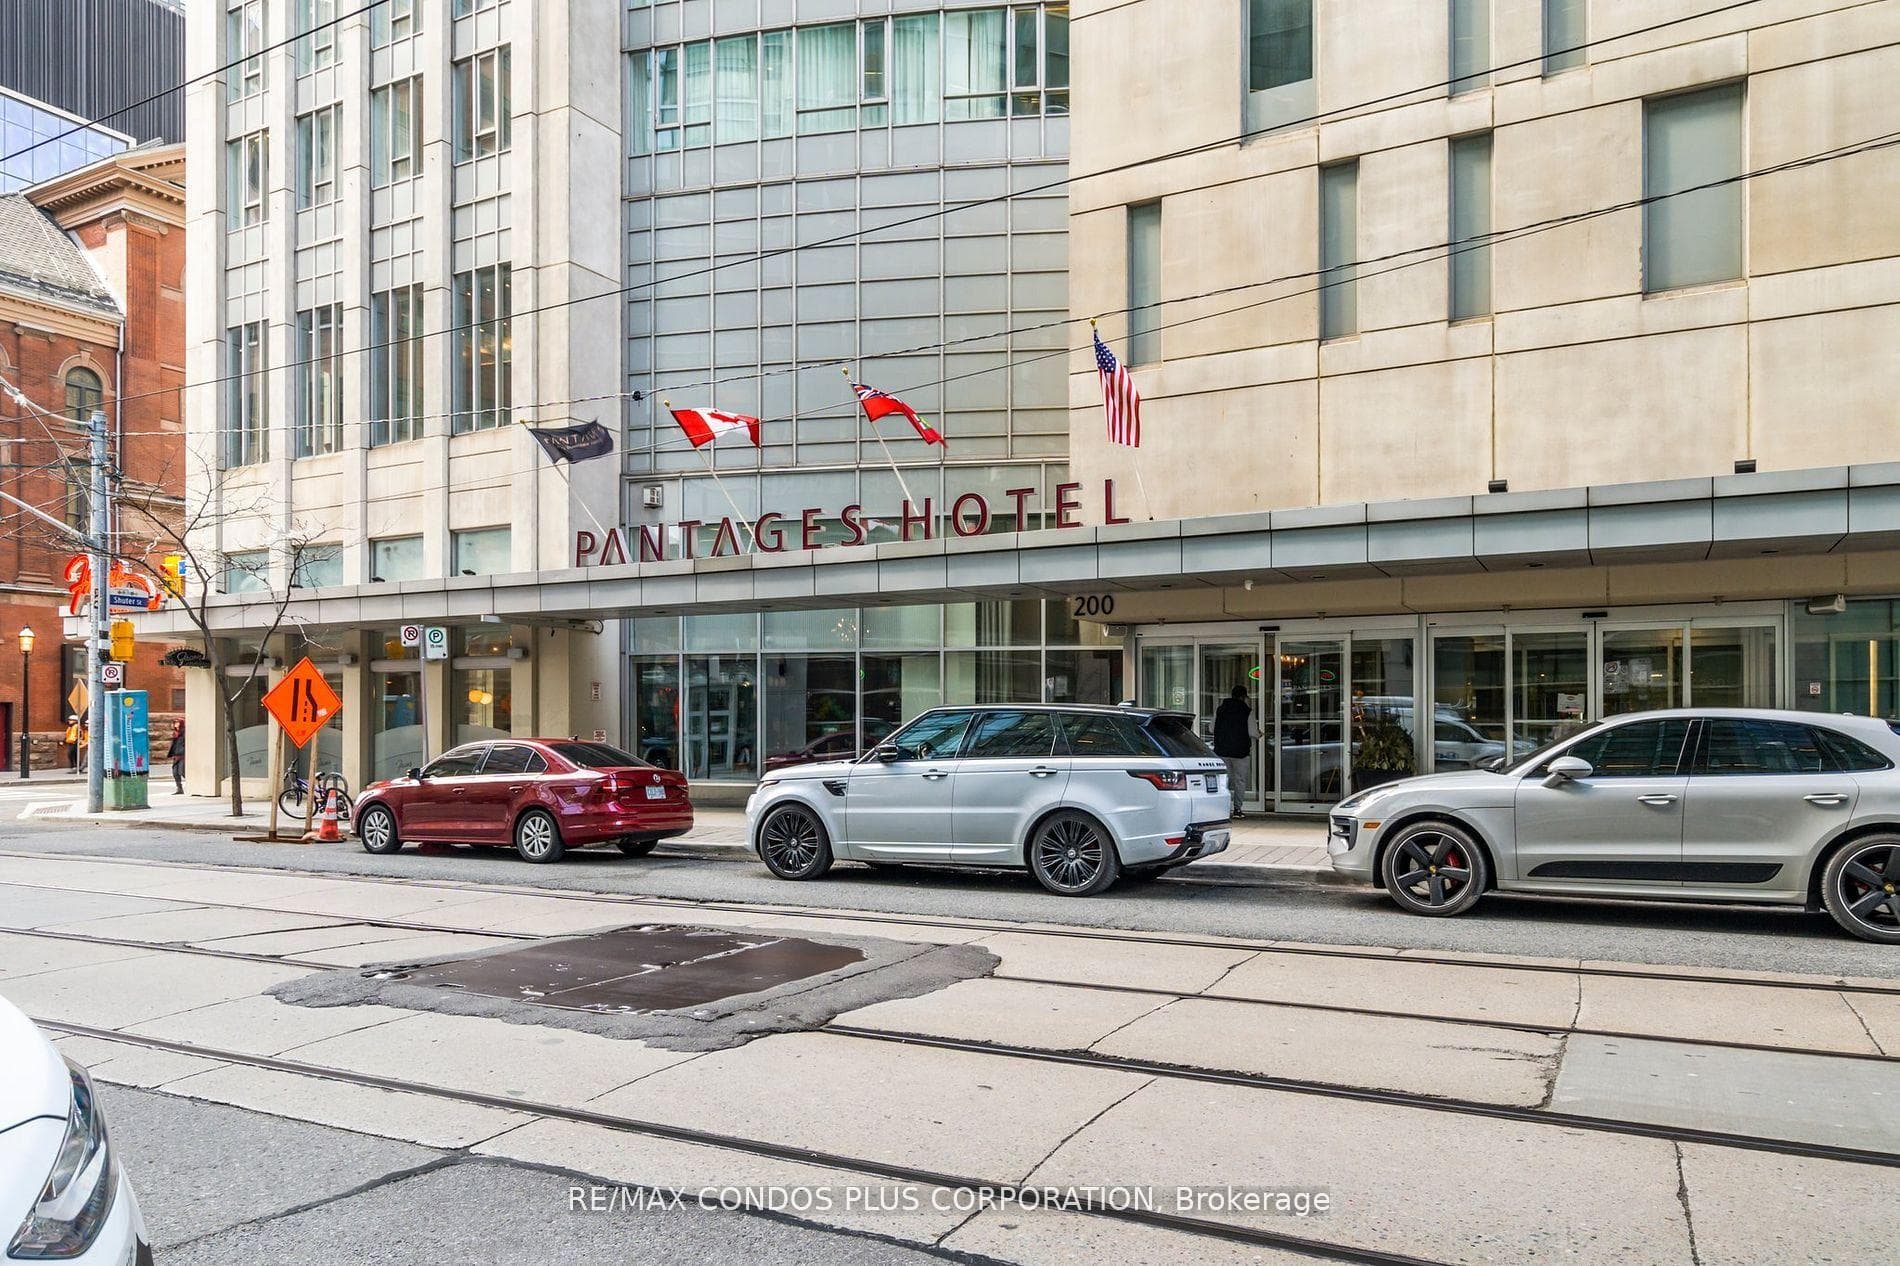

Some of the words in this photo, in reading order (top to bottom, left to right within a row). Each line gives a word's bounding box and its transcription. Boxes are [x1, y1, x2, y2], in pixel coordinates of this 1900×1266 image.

[575, 504, 866, 568] PANTAGES
[902, 478, 1131, 542] HOTEL
[113, 596, 135, 606] Shuter
[1073, 594, 1115, 617] 200
